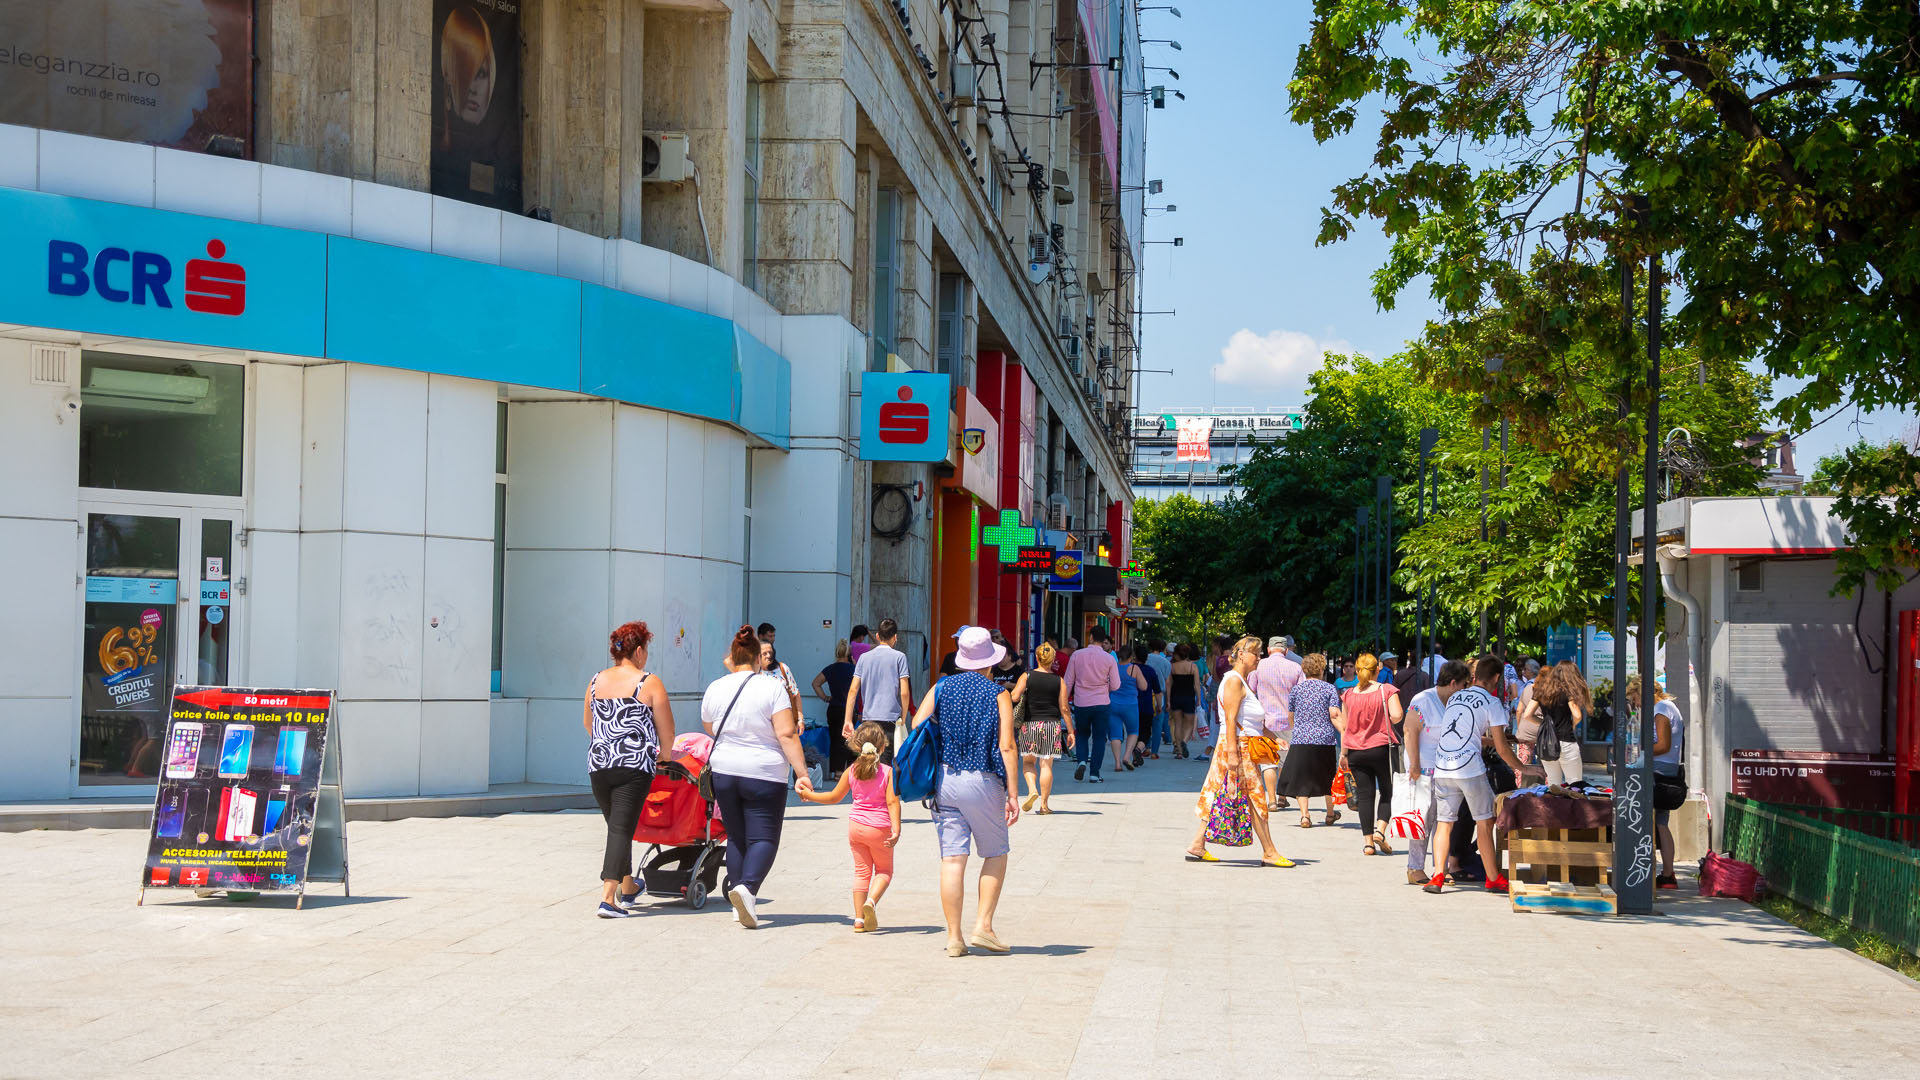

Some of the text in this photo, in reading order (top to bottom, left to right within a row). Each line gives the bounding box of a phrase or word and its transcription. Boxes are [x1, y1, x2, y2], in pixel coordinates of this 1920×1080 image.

[0, 45, 161, 87] eleganzzia.ro
[99, 89, 114, 101] de
[116, 93, 157, 107] mireasa
[48, 239, 173, 309] BCR
[201, 591, 219, 600] BCR
[108, 678, 154, 696] CREDITUL
[115, 688, 150, 705] DIVERS
[244, 696, 288, 706] 50 metri
[1448, 693, 1483, 709] PARIS
[173, 710, 325, 723] orice folie de sticla 10 lei
[1737, 766, 1751, 776] LG
[1754, 767, 1778, 777] UHD
[1780, 768, 1795, 777] TV
[162, 848, 288, 859] ACCESORII TELEFOANE
